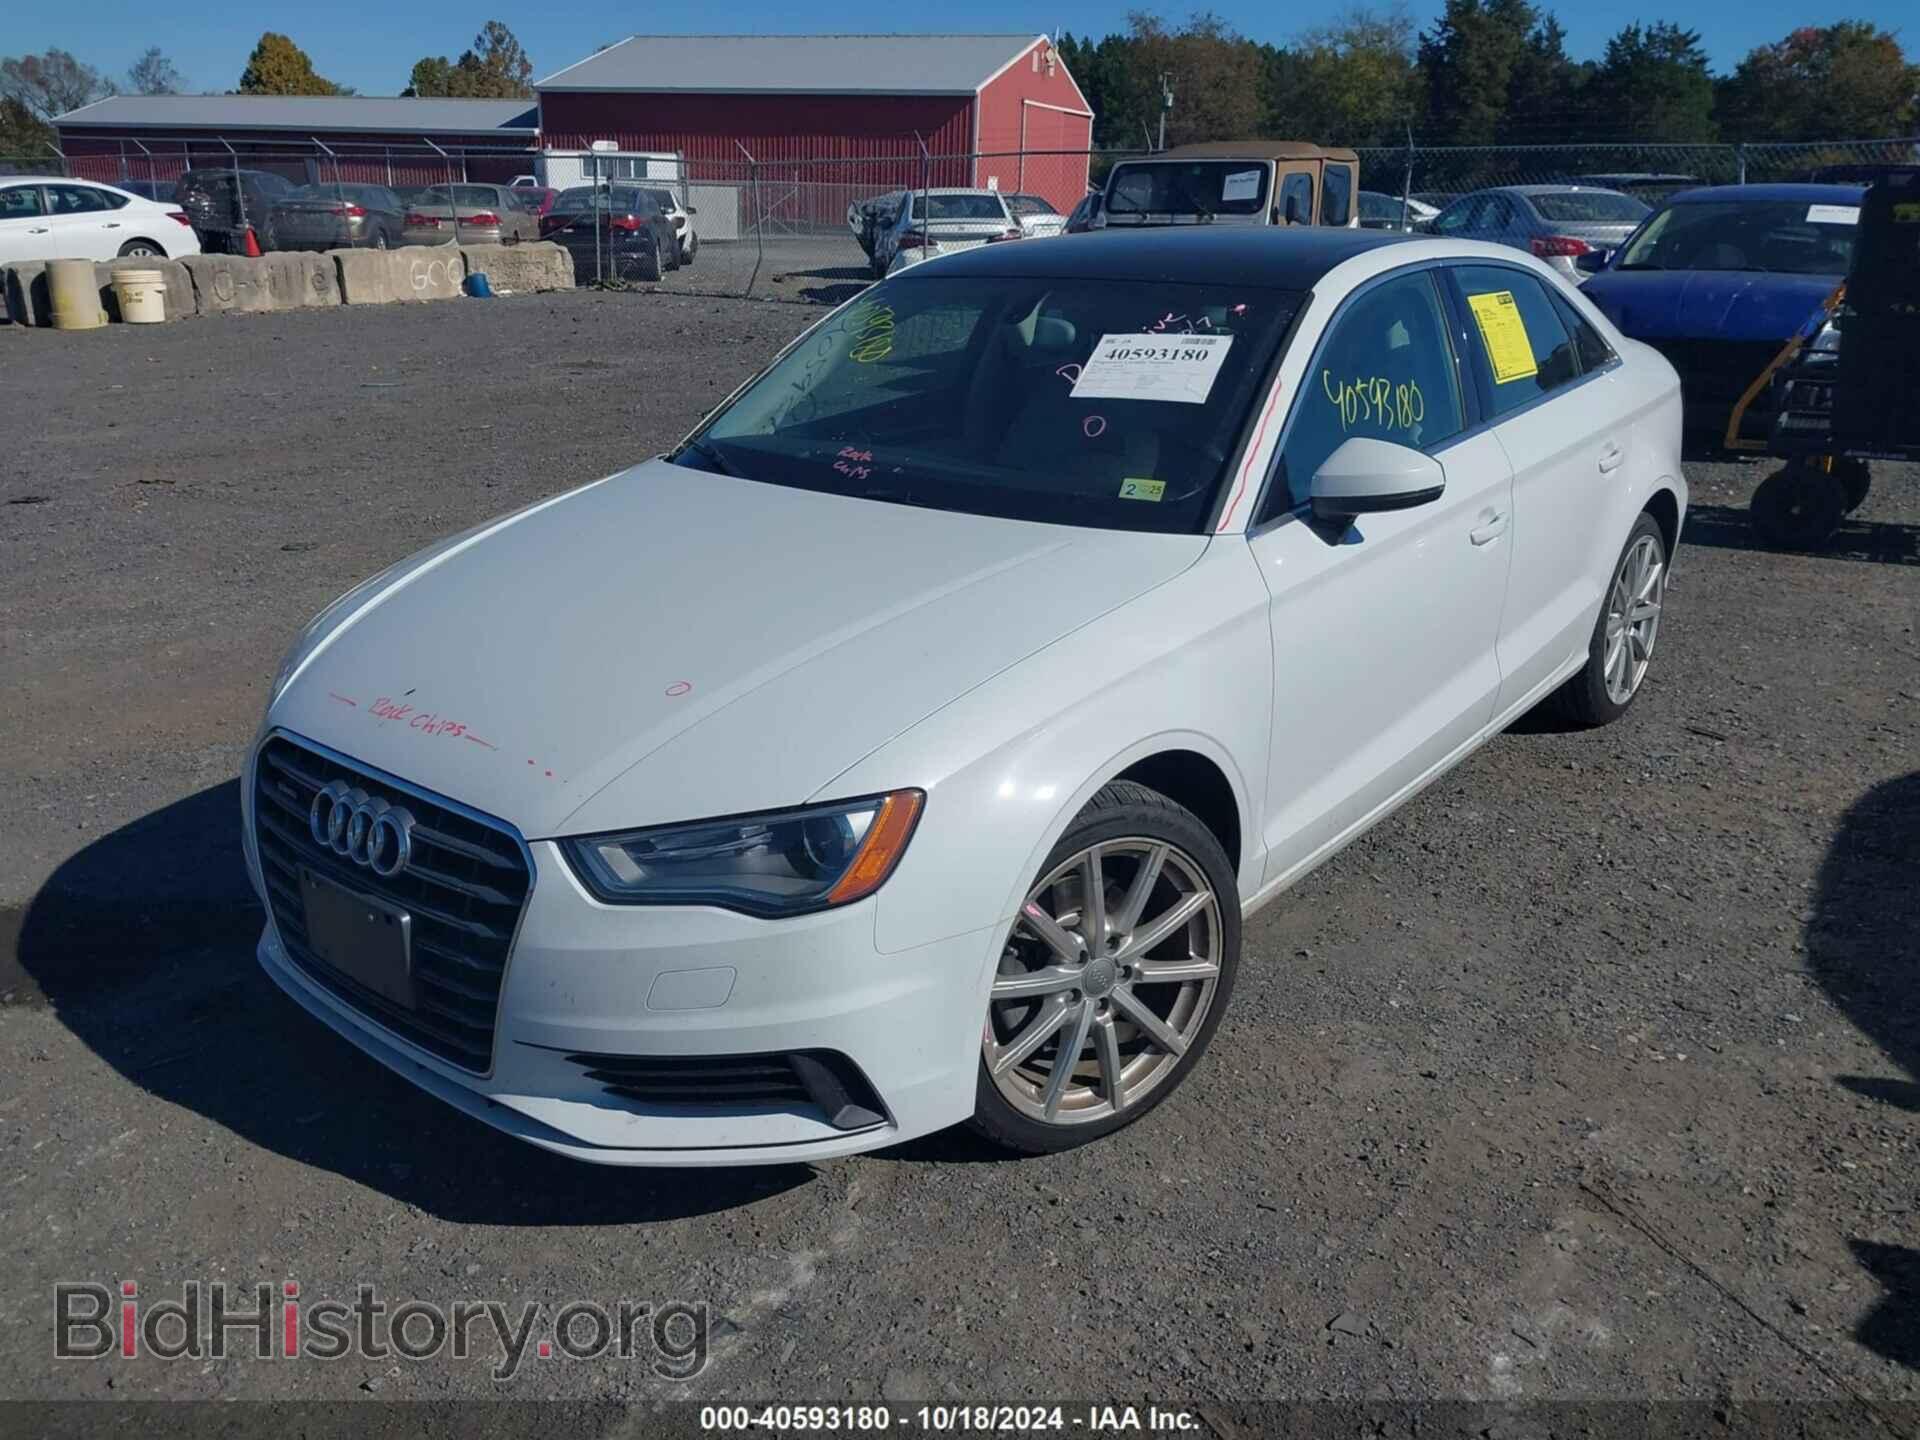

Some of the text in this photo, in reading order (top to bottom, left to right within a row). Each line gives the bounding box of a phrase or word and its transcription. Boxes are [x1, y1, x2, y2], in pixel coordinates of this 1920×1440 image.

[1104, 348, 1209, 361] 40593180
[1323, 369, 1424, 432] 40593180
[1125, 483, 1162, 496] 2 25
